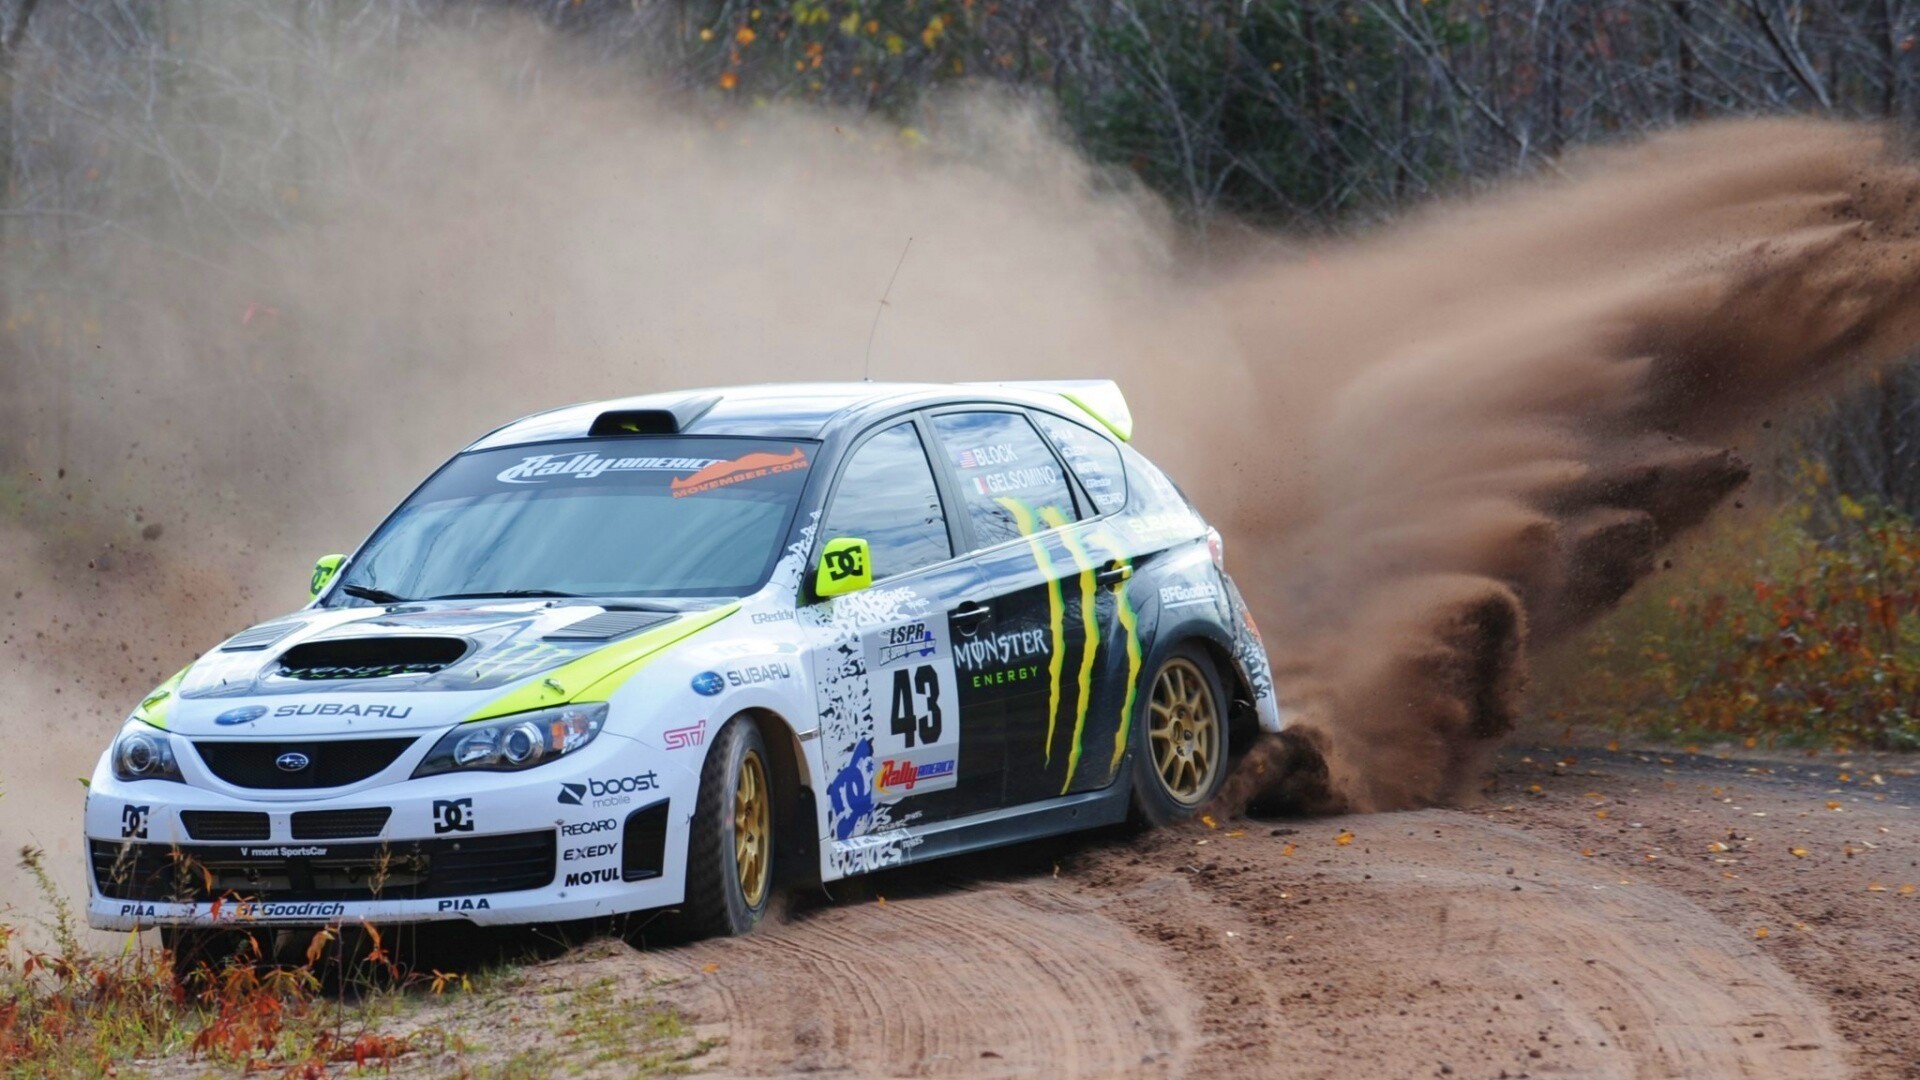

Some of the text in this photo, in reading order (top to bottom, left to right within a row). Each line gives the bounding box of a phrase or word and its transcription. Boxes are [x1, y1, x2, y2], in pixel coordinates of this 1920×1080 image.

[974, 443, 1018, 467] BLOCK
[496, 451, 616, 483] Rally
[672, 460, 809, 499] MOVEMBER.COM
[985, 465, 1056, 493] GELSOMINO
[824, 545, 863, 581] DC
[751, 610, 794, 625] GReddy
[889, 623, 925, 645] LSPR
[727, 662, 791, 687] SUBARU
[972, 665, 1038, 688] ENERGY
[273, 703, 413, 719] SUBARU
[890, 664, 942, 749] 43
[588, 770, 660, 797] boost
[876, 759, 918, 793] Rally
[592, 795, 631, 808] mobile
[121, 804, 150, 839] DC
[432, 798, 474, 834] DC
[561, 818, 617, 837] RECARO
[241, 846, 328, 857] Vrmont SportsCar
[563, 843, 618, 861] EXEDY
[565, 868, 620, 887] MOTUL
[121, 904, 155, 916] PIAA
[438, 898, 490, 912] PIAA
